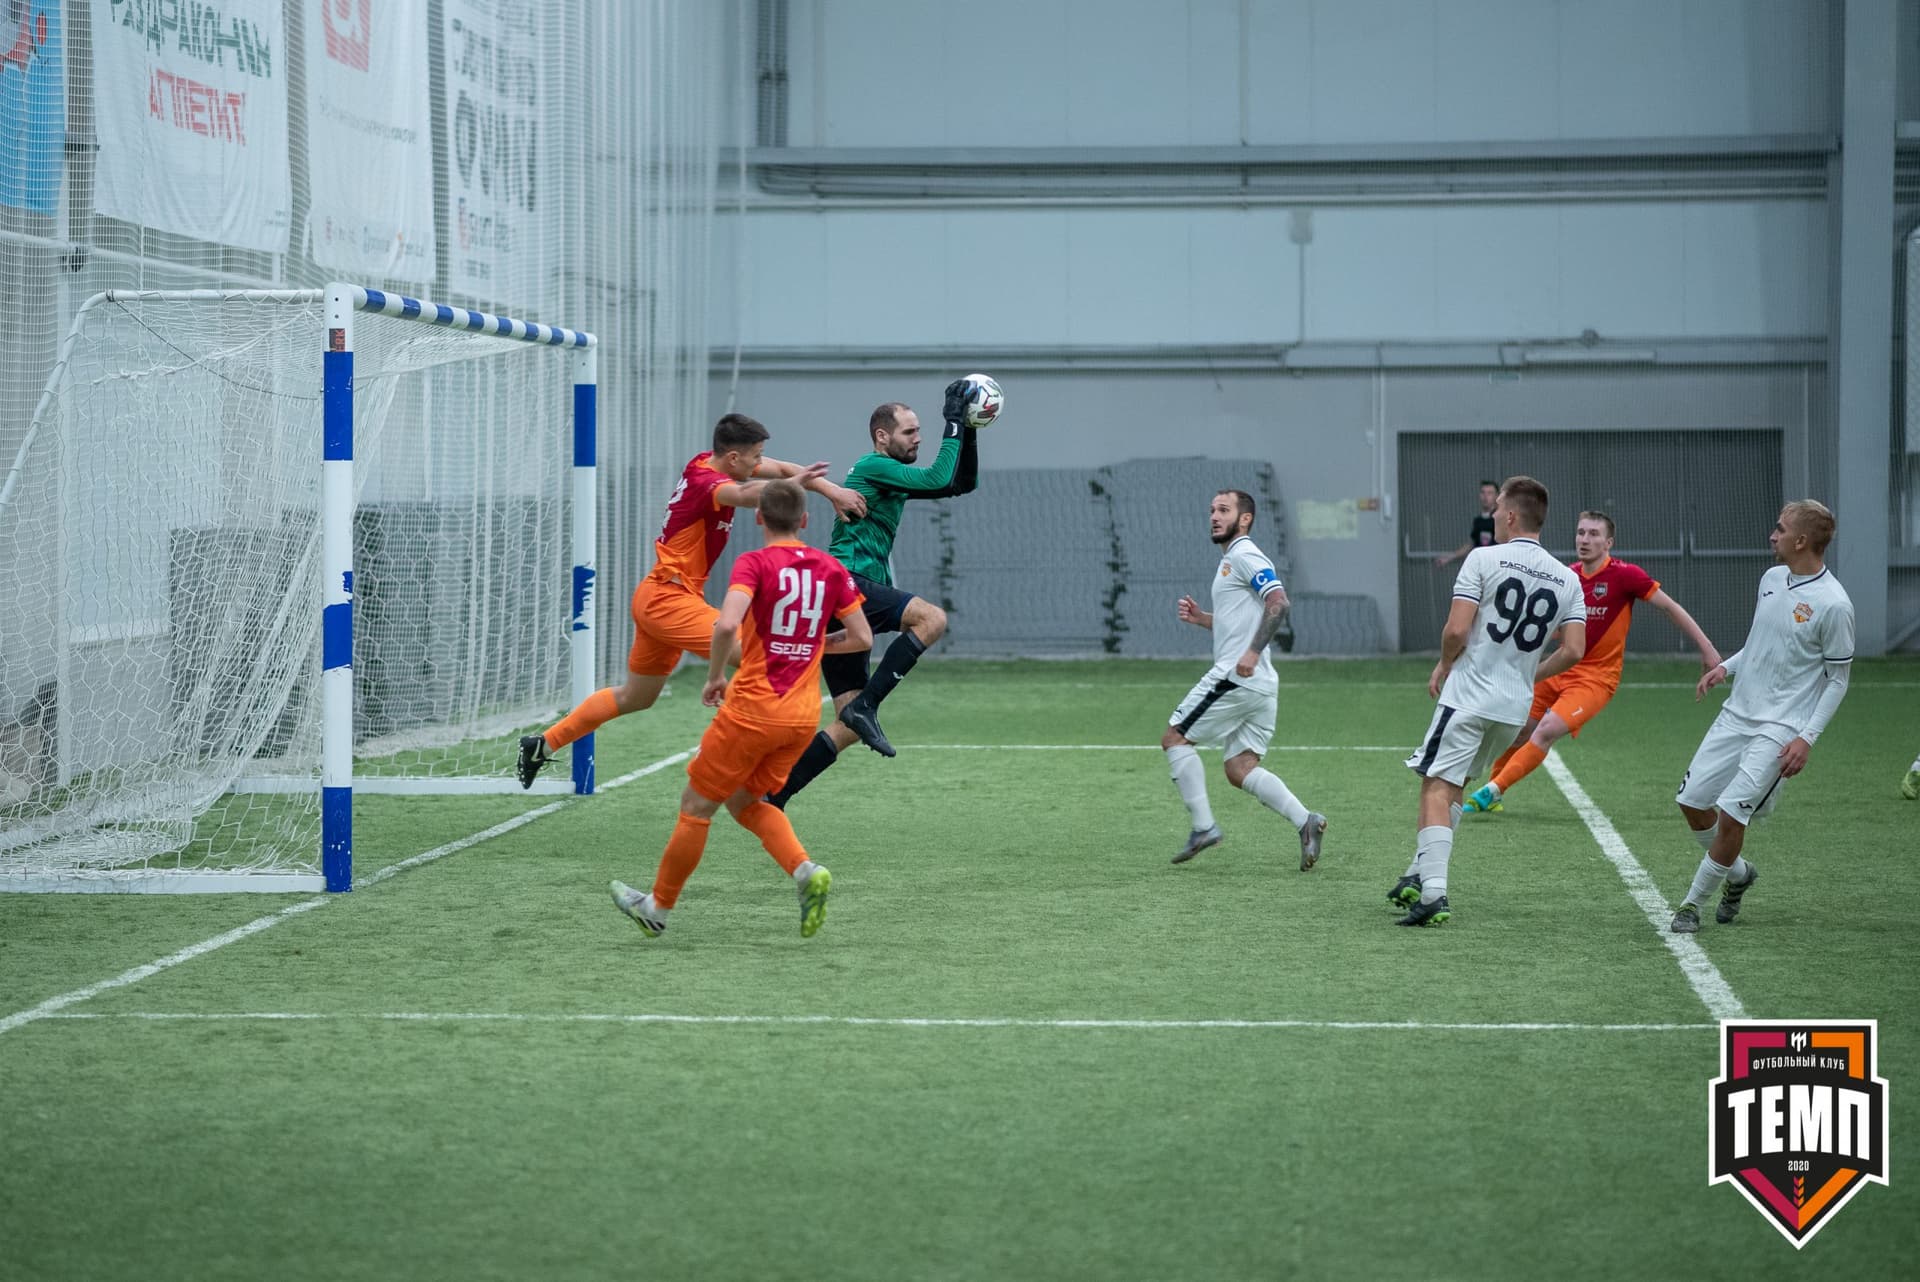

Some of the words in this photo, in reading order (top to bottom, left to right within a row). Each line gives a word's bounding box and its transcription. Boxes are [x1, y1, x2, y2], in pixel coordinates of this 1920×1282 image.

[771, 567, 825, 637] 24
[1256, 572, 1268, 586] C
[1486, 577, 1559, 653] 98
